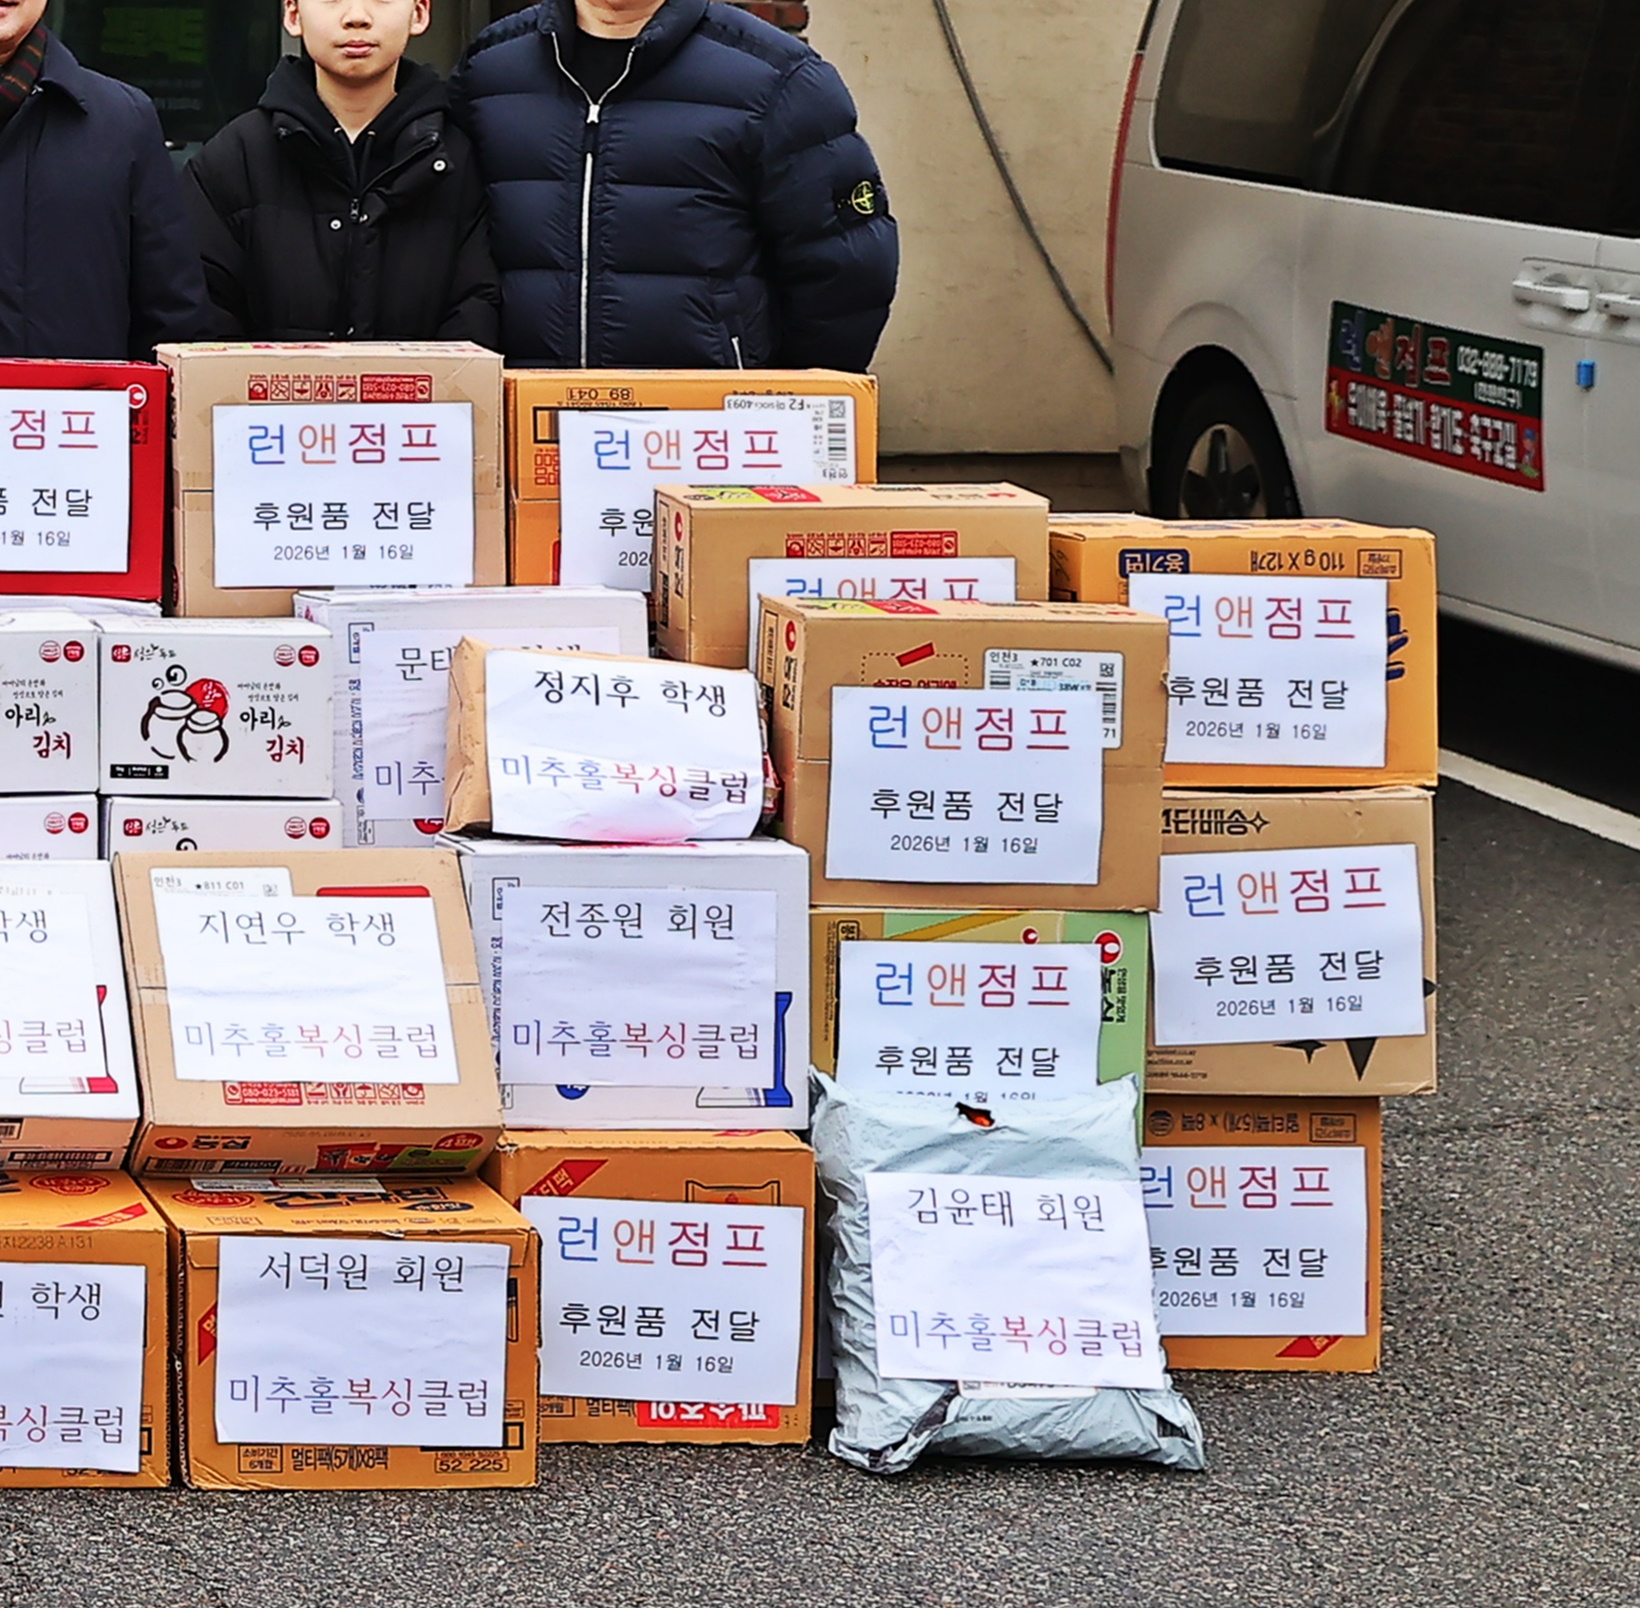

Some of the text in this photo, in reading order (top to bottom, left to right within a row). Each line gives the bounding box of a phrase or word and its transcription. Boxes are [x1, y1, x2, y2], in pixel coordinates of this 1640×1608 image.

[249, 423, 440, 465] 런앤점프
[594, 430, 782, 470] 런앤점프
[1165, 596, 1355, 639] 런앤점프
[535, 671, 730, 718] 정지후 학생
[1170, 678, 1348, 710] 후원품 전달
[869, 706, 1070, 751] 런앤점프
[266, 735, 305, 765] 김치
[502, 755, 748, 804] 미추홀복싱클럽
[1184, 868, 1386, 917] 런앤점프
[200, 911, 395, 946] 지연우 학생
[541, 901, 734, 940] 전종원 회원
[876, 963, 1070, 1007] 런앤점프
[1194, 950, 1384, 986] 후원품 전달
[179, 1022, 438, 1064] 미추홀복싱클럽
[513, 1020, 757, 1059] 미추홀복싱클럽
[1144, 1163, 1333, 1210] 런앤점프
[909, 1188, 1104, 1232] 김윤태 회원
[558, 1217, 767, 1267] 런앤점프
[260, 1252, 463, 1292] 서덕원 회원
[31, 1282, 100, 1321] 학생
[890, 1311, 1142, 1357] 미추홀복싱클럽
[230, 1375, 487, 1417] 미추홀복싱클럽
